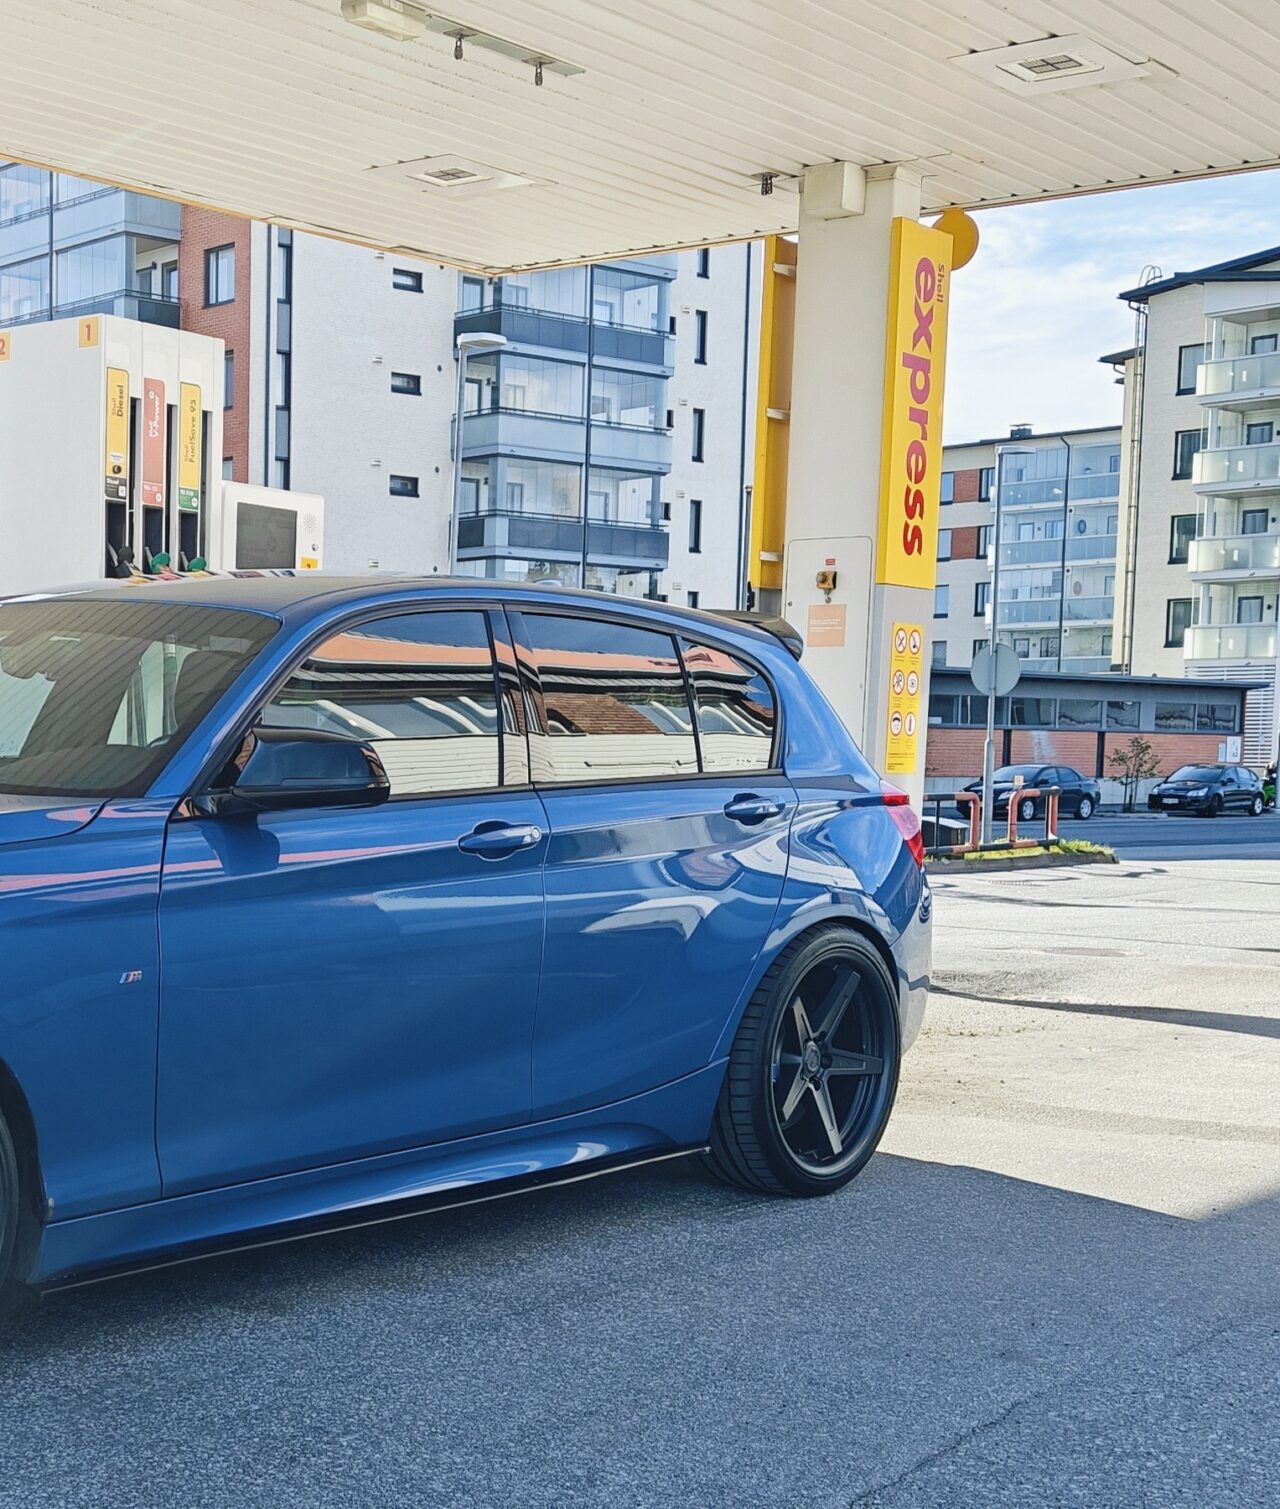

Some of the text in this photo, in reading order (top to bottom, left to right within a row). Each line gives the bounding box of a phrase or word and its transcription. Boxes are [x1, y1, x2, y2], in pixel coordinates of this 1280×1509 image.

[937, 263, 945, 303] Shell
[85, 323, 91, 342] 1
[116, 384, 124, 417] Diesel
[152, 394, 160, 438] V-Power
[902, 257, 936, 556] express
[189, 399, 197, 463] FuelSave 95
